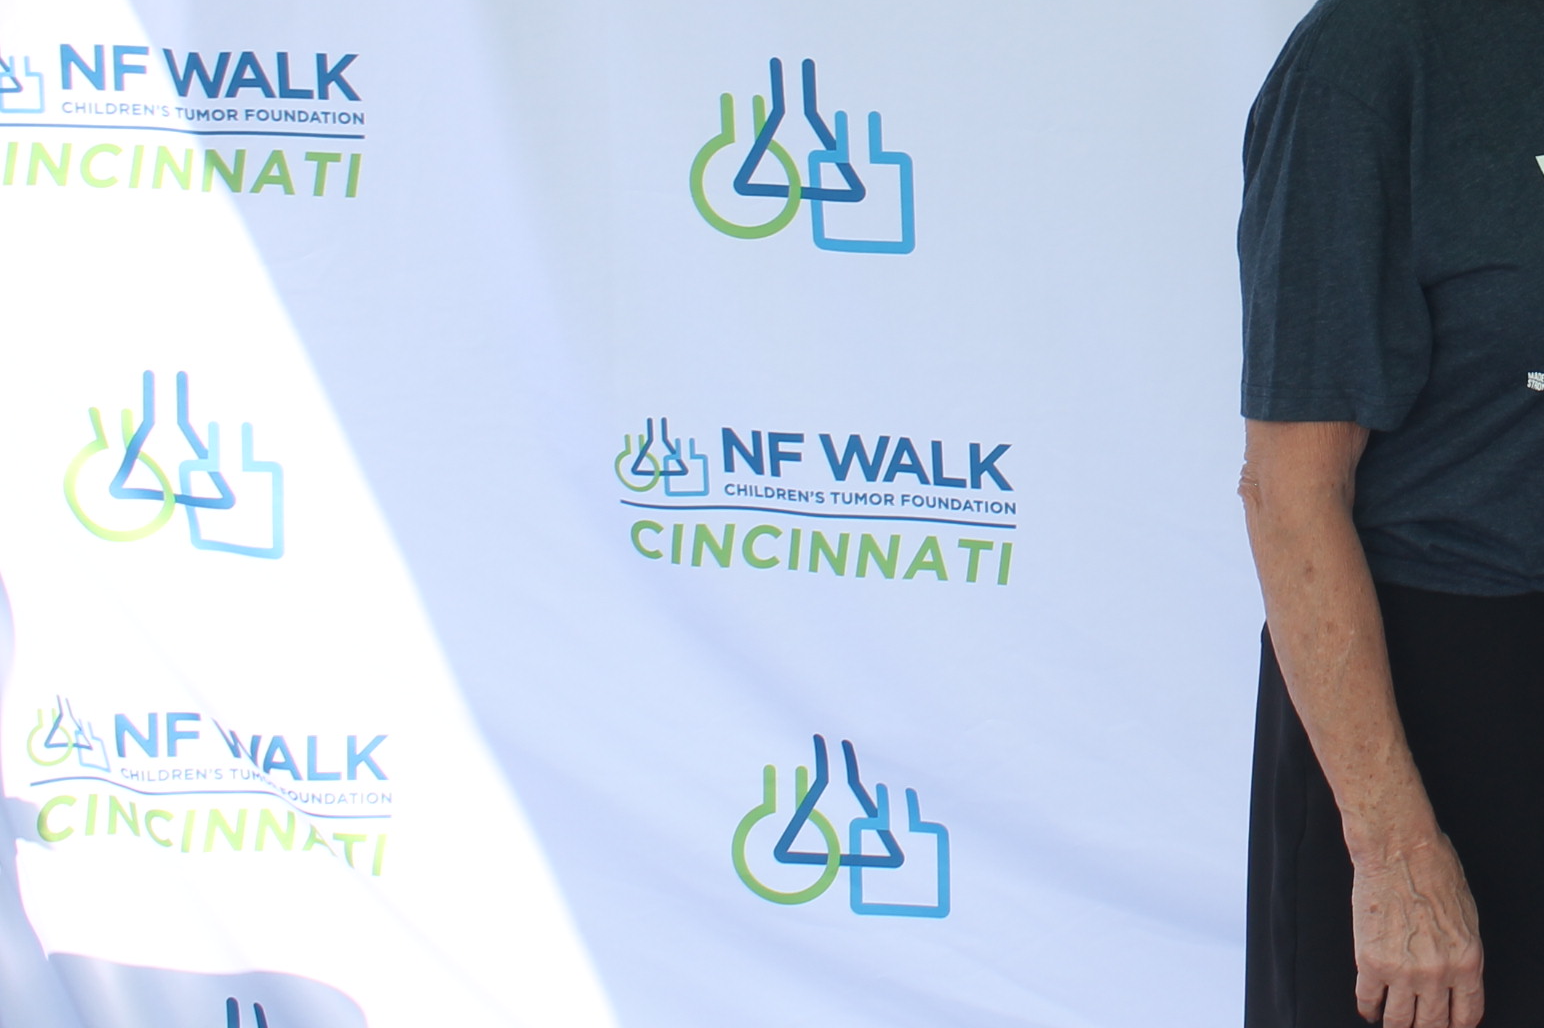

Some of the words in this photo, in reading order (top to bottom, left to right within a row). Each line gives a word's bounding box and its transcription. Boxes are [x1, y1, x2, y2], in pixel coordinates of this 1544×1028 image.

[59, 43, 149, 92] NF
[162, 48, 362, 101] WALK
[62, 101, 170, 118] CHILDREN'S
[176, 106, 238, 122] TUMOR
[244, 109, 365, 125] FOUNDATION
[2, 141, 362, 198] INCINNATI
[722, 427, 804, 477] NF
[819, 433, 1014, 492] WALK
[724, 483, 825, 504] CHILDREN'S
[830, 491, 895, 506] TUMOR
[901, 493, 1016, 515] FOUNDATION
[630, 519, 1013, 586] CINCINNATI
[114, 712, 201, 758] NF
[120, 767, 224, 782] CHILDREN'S
[36, 793, 388, 877] CINCINNATI
